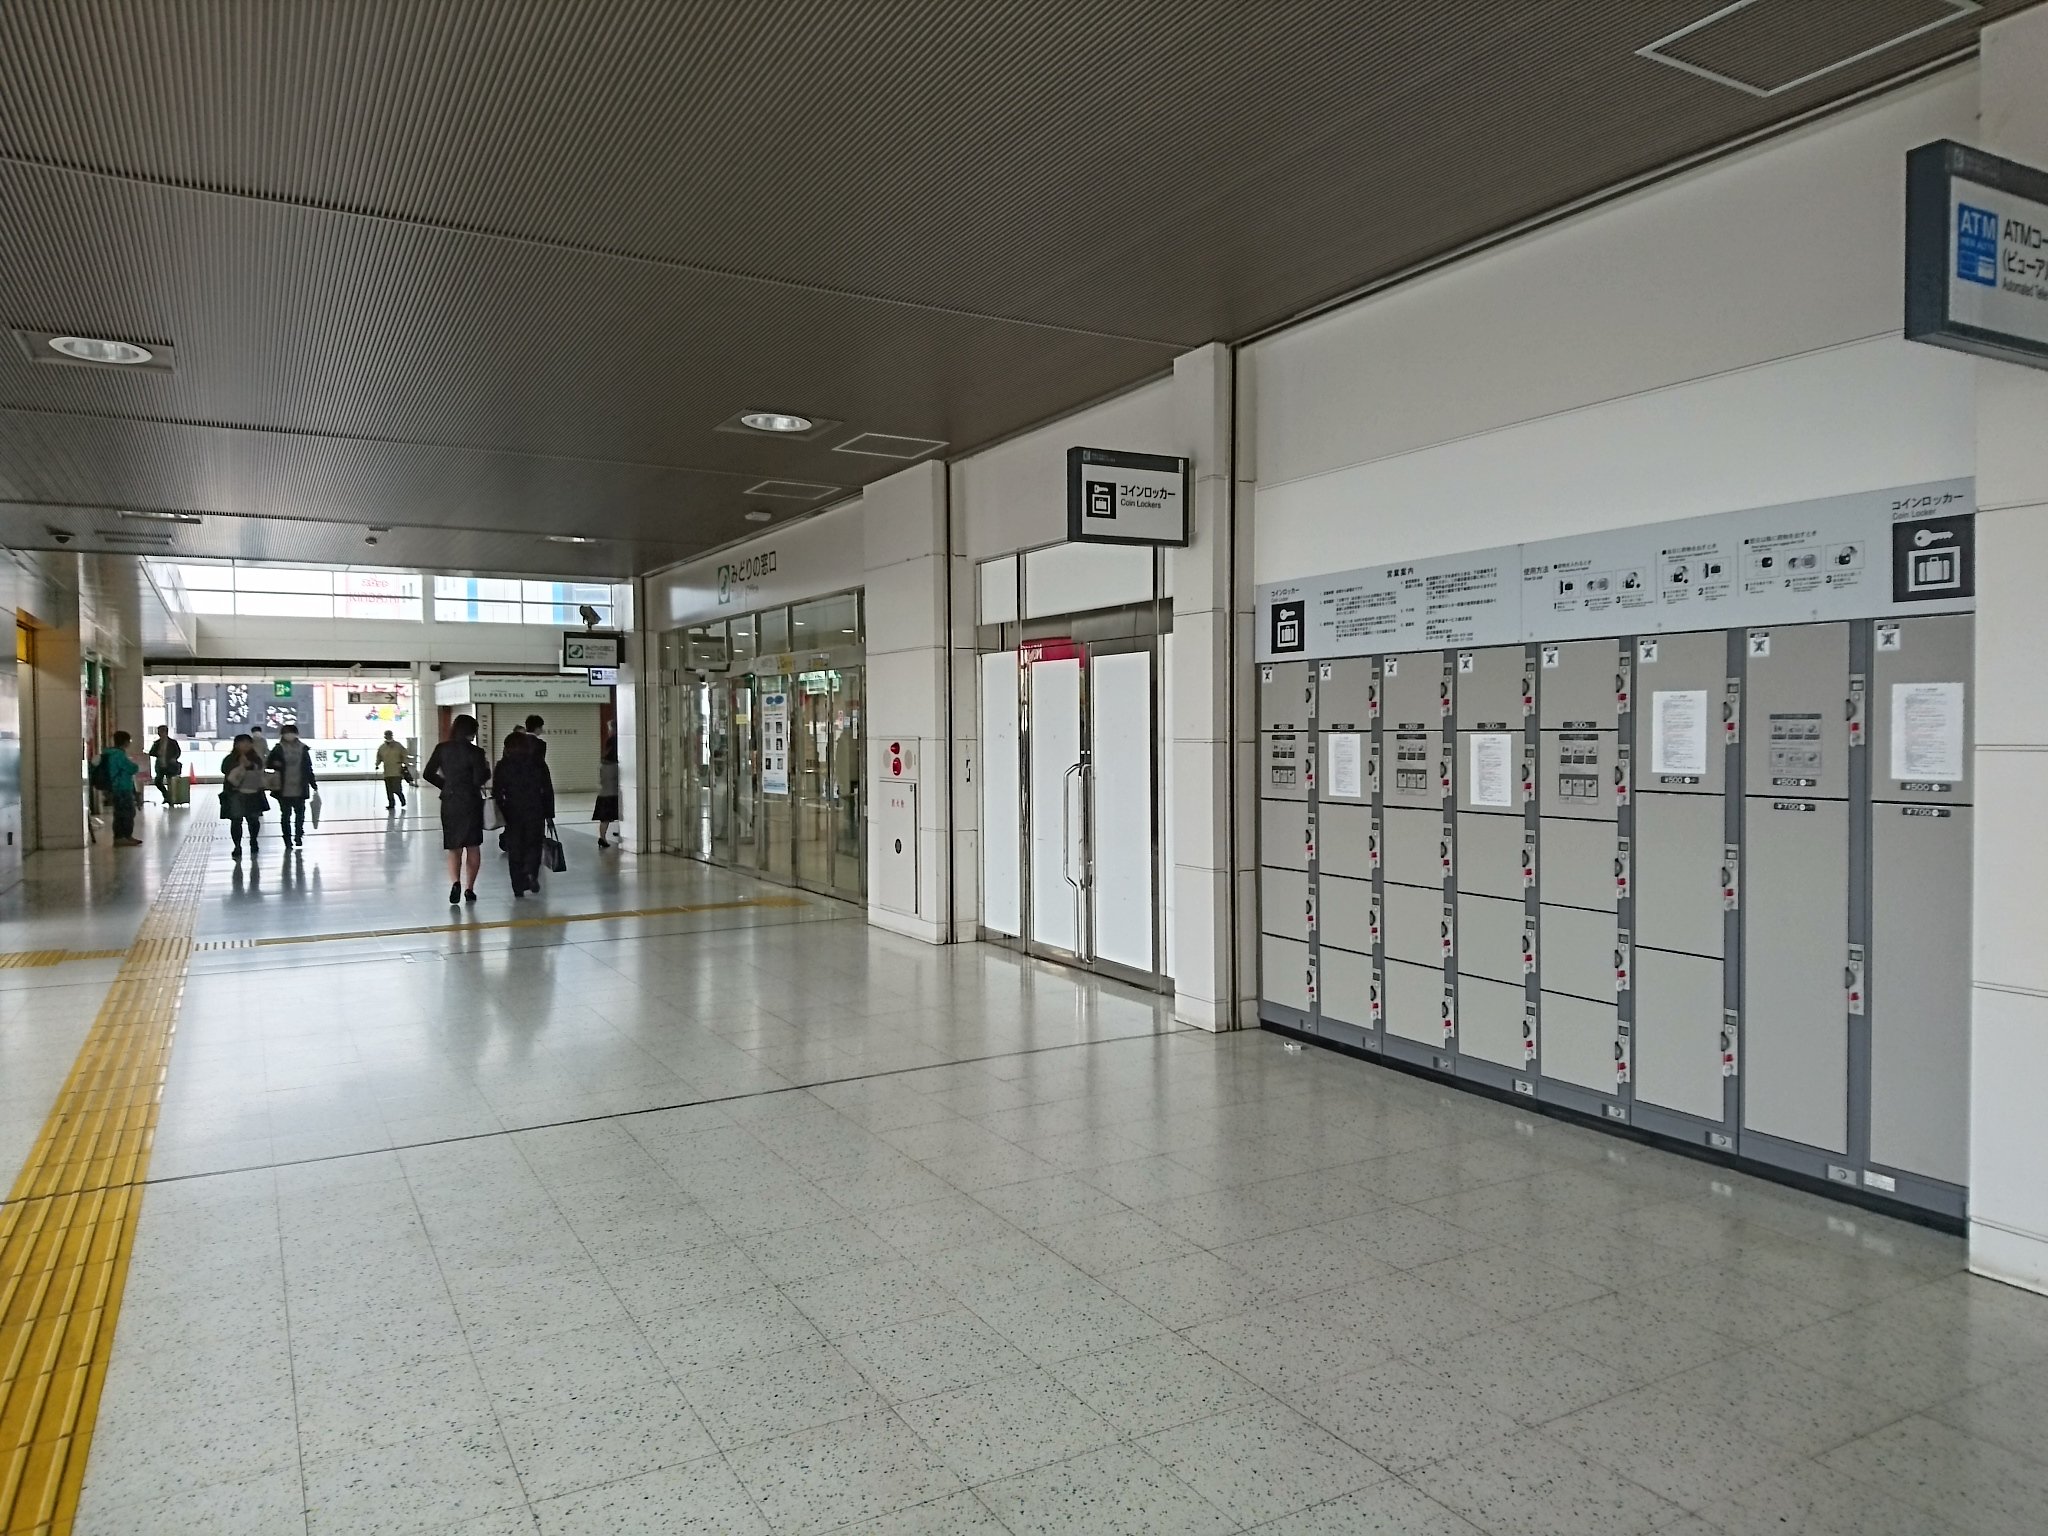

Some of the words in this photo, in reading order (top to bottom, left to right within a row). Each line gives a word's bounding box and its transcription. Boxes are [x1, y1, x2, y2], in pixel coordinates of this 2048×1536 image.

[1961, 210, 1996, 240] ATM
[1120, 484, 1176, 500] コインロッカー
[1120, 498, 1136, 507] Coin
[1137, 500, 1161, 509] Lockers
[1892, 492, 1964, 510] コインロッカー
[1893, 511, 1909, 520] Coin
[1912, 508, 1936, 518] Locker
[731, 550, 777, 584] みどりの窓口
